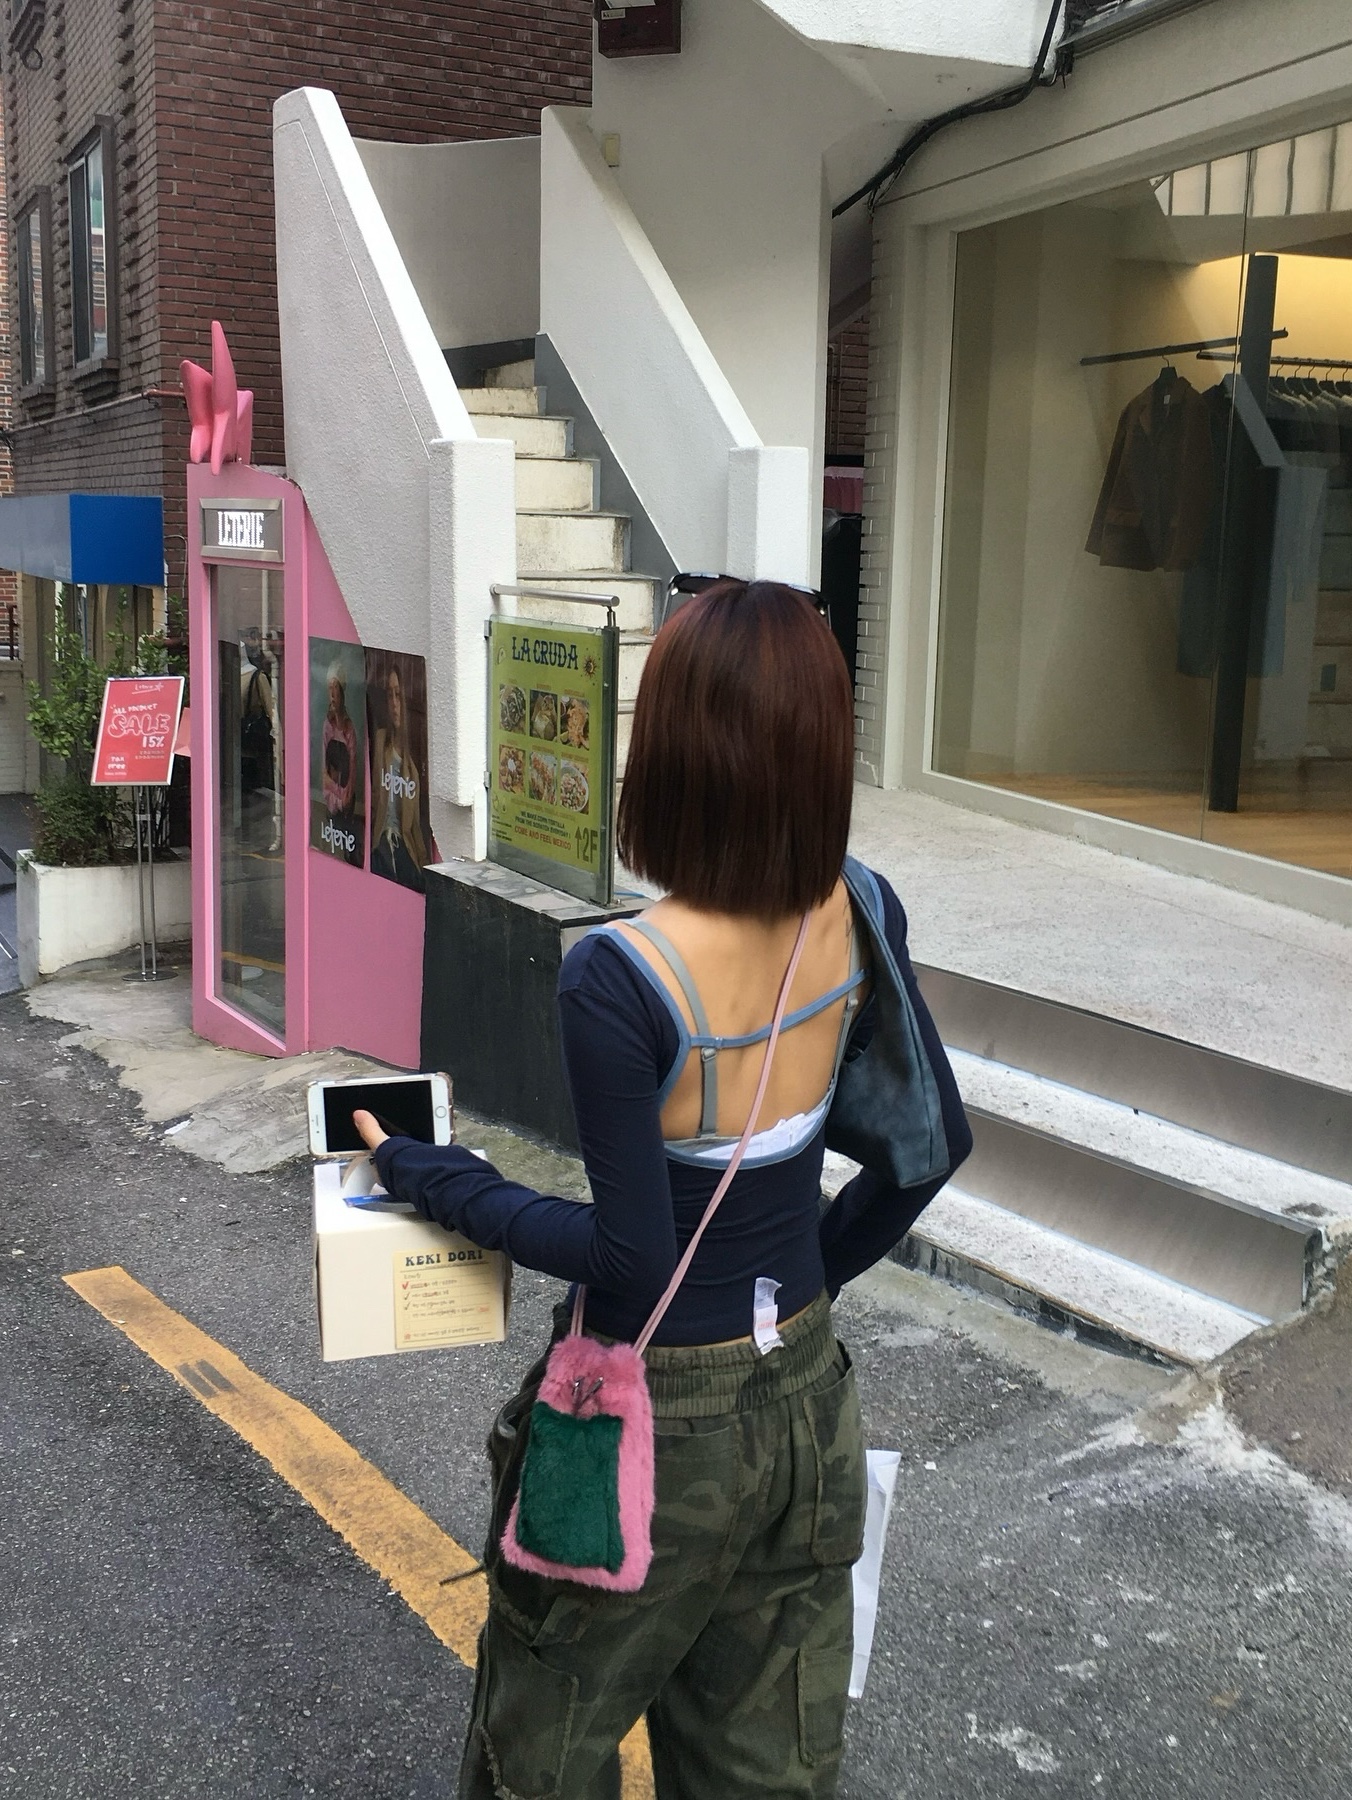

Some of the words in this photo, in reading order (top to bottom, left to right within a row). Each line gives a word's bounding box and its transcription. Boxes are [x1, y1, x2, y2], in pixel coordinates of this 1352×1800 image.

[512, 636, 531, 662] LA
[533, 639, 579, 670] CRUDA
[107, 713, 171, 738] SALE
[142, 735, 165, 748] 15%
[515, 816, 525, 824] FROM
[514, 825, 528, 837] COME
[529, 830, 540, 840] AND
[540, 833, 552, 845] FEEL
[552, 837, 571, 850] MEXICO
[582, 827, 598, 864] 2F
[405, 1253, 441, 1267] KEKI
[448, 1249, 483, 1262] DORI
